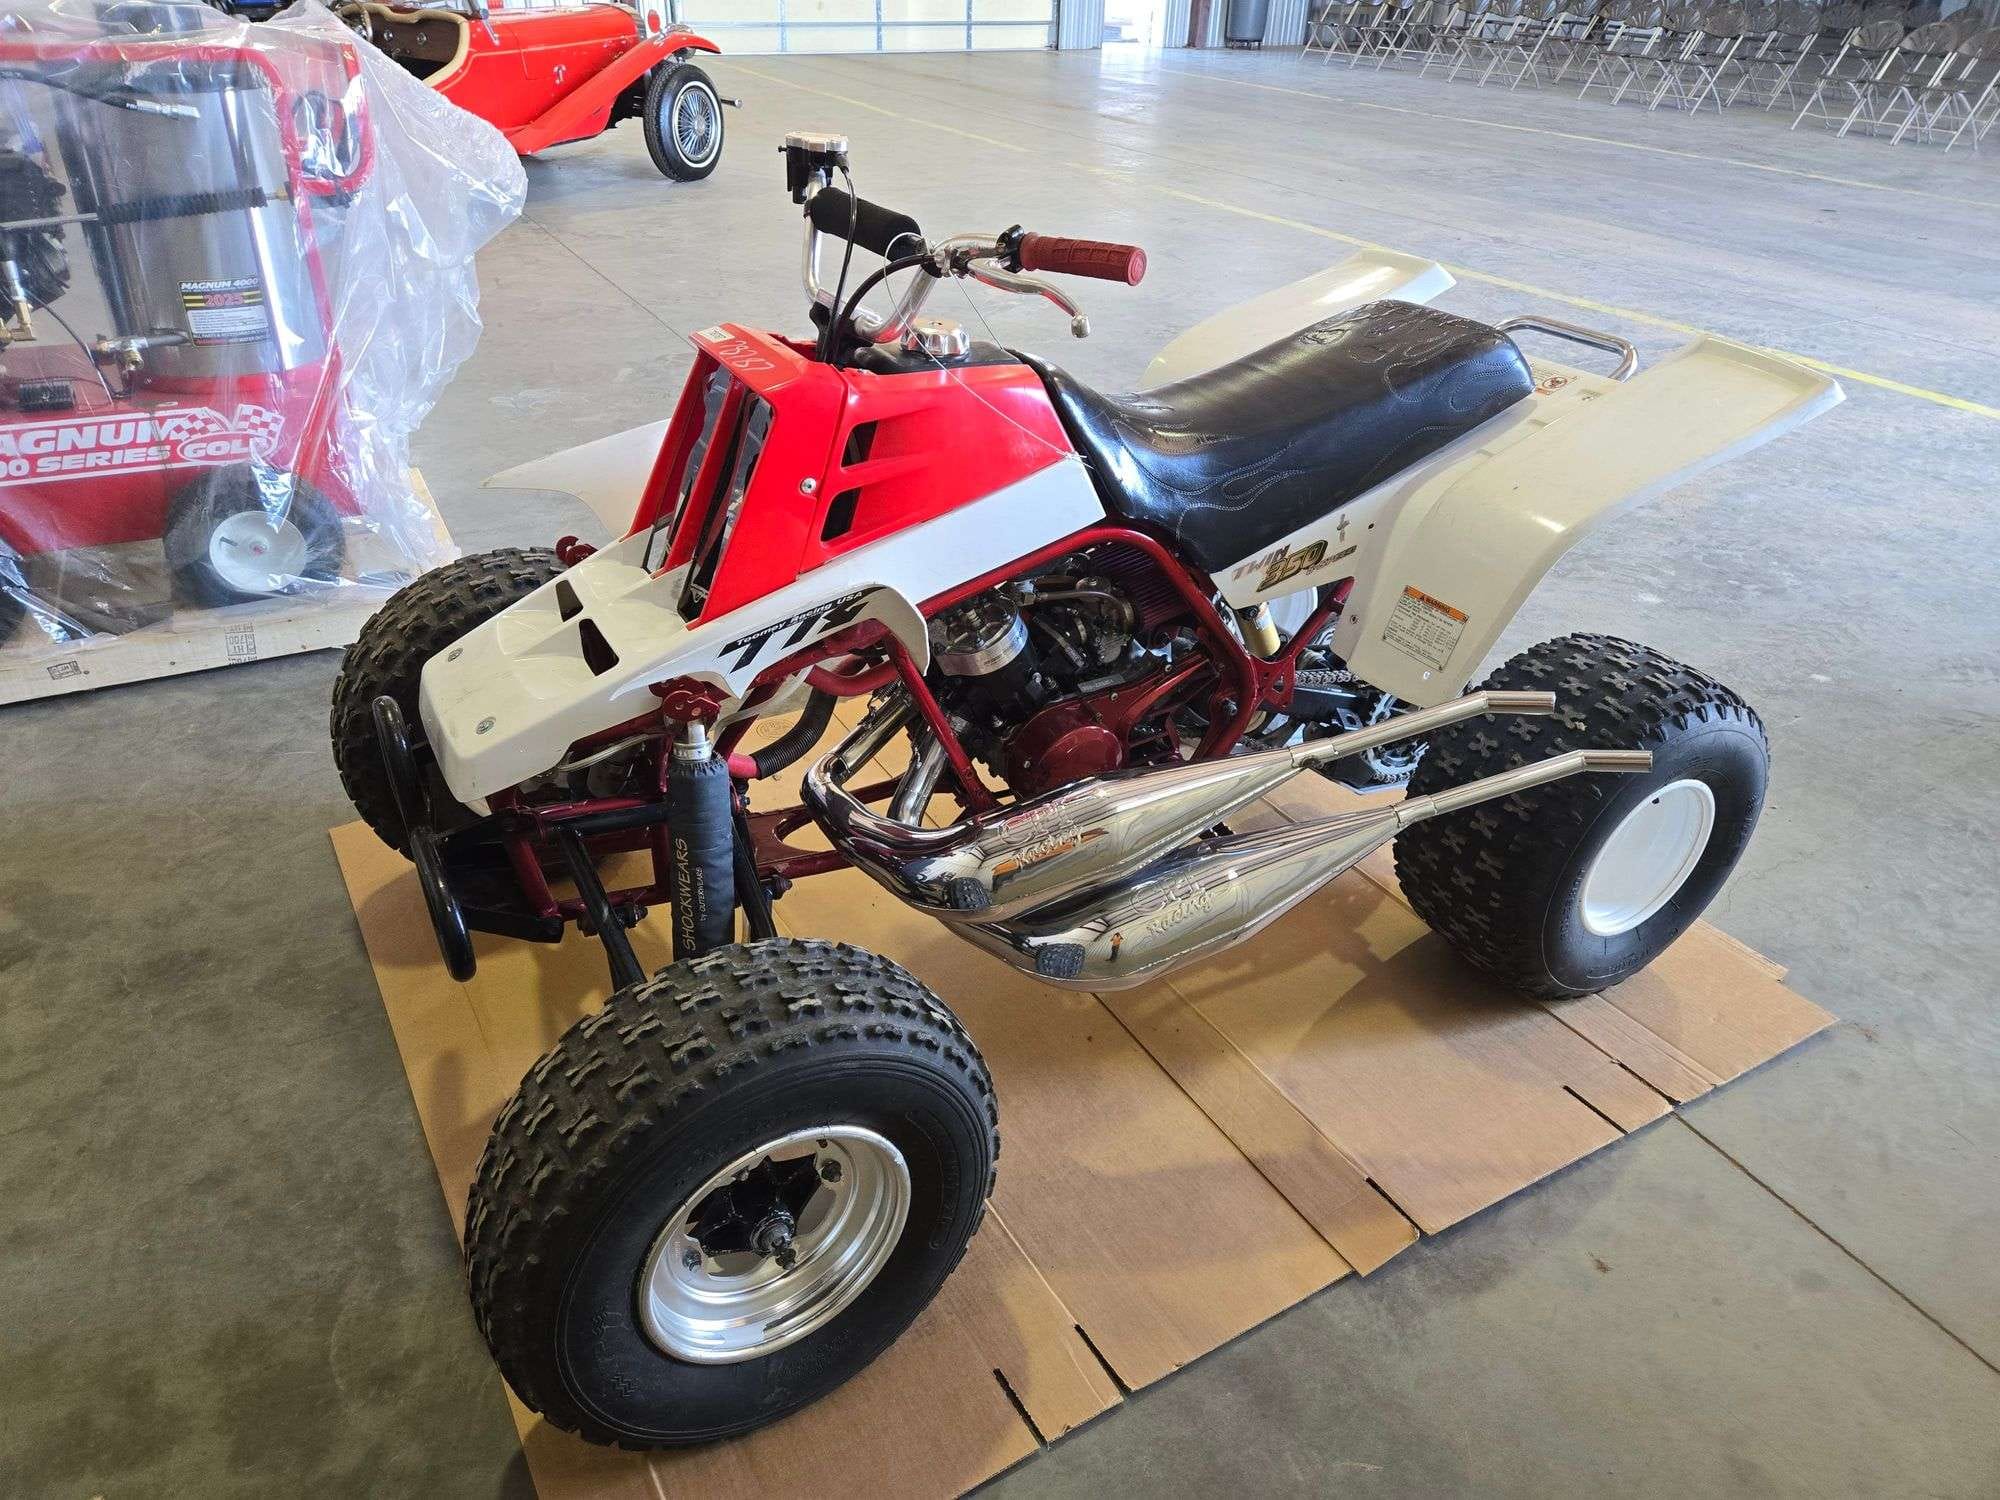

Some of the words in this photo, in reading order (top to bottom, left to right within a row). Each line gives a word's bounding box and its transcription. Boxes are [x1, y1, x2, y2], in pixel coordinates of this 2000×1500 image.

[181, 280, 231, 290] MAGNUM
[234, 277, 258, 287] 4000
[0, 417, 186, 457] AGNUM
[36, 444, 170, 473] SERIES
[183, 438, 252, 459] GOL
[1232, 544, 1291, 581] TWIN
[1258, 540, 1328, 591] 350
[736, 622, 786, 646] Toomey
[790, 602, 832, 624] Racing
[836, 591, 863, 605] USA
[1014, 822, 1083, 869] Racing
[675, 838, 697, 951] SHOCKWEARS
[1145, 889, 1215, 938] Racing
